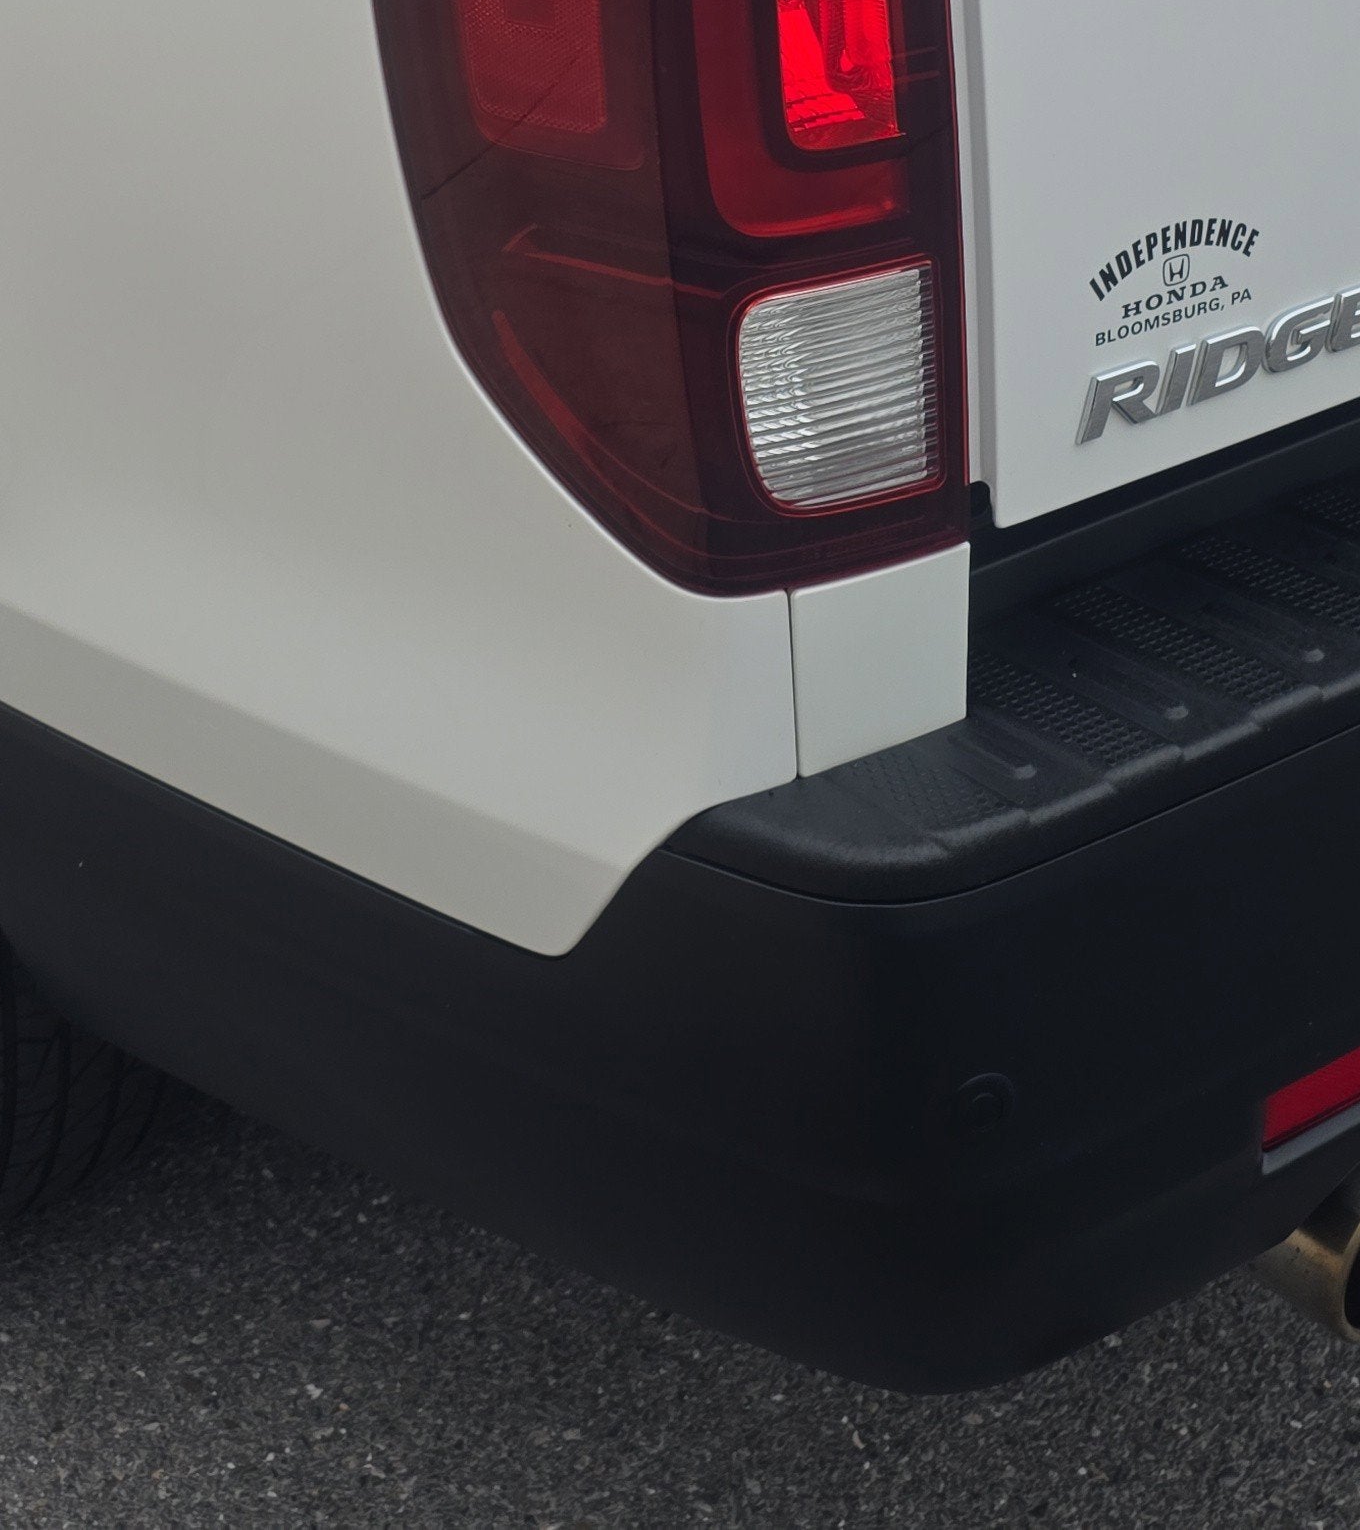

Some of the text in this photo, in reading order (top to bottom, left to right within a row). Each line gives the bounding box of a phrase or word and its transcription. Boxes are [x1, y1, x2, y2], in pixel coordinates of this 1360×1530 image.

[1089, 218, 1260, 301] INDEPENDENCE
[1095, 288, 1253, 346] BLOOMSBURG, PA
[1121, 275, 1229, 319] HONDA
